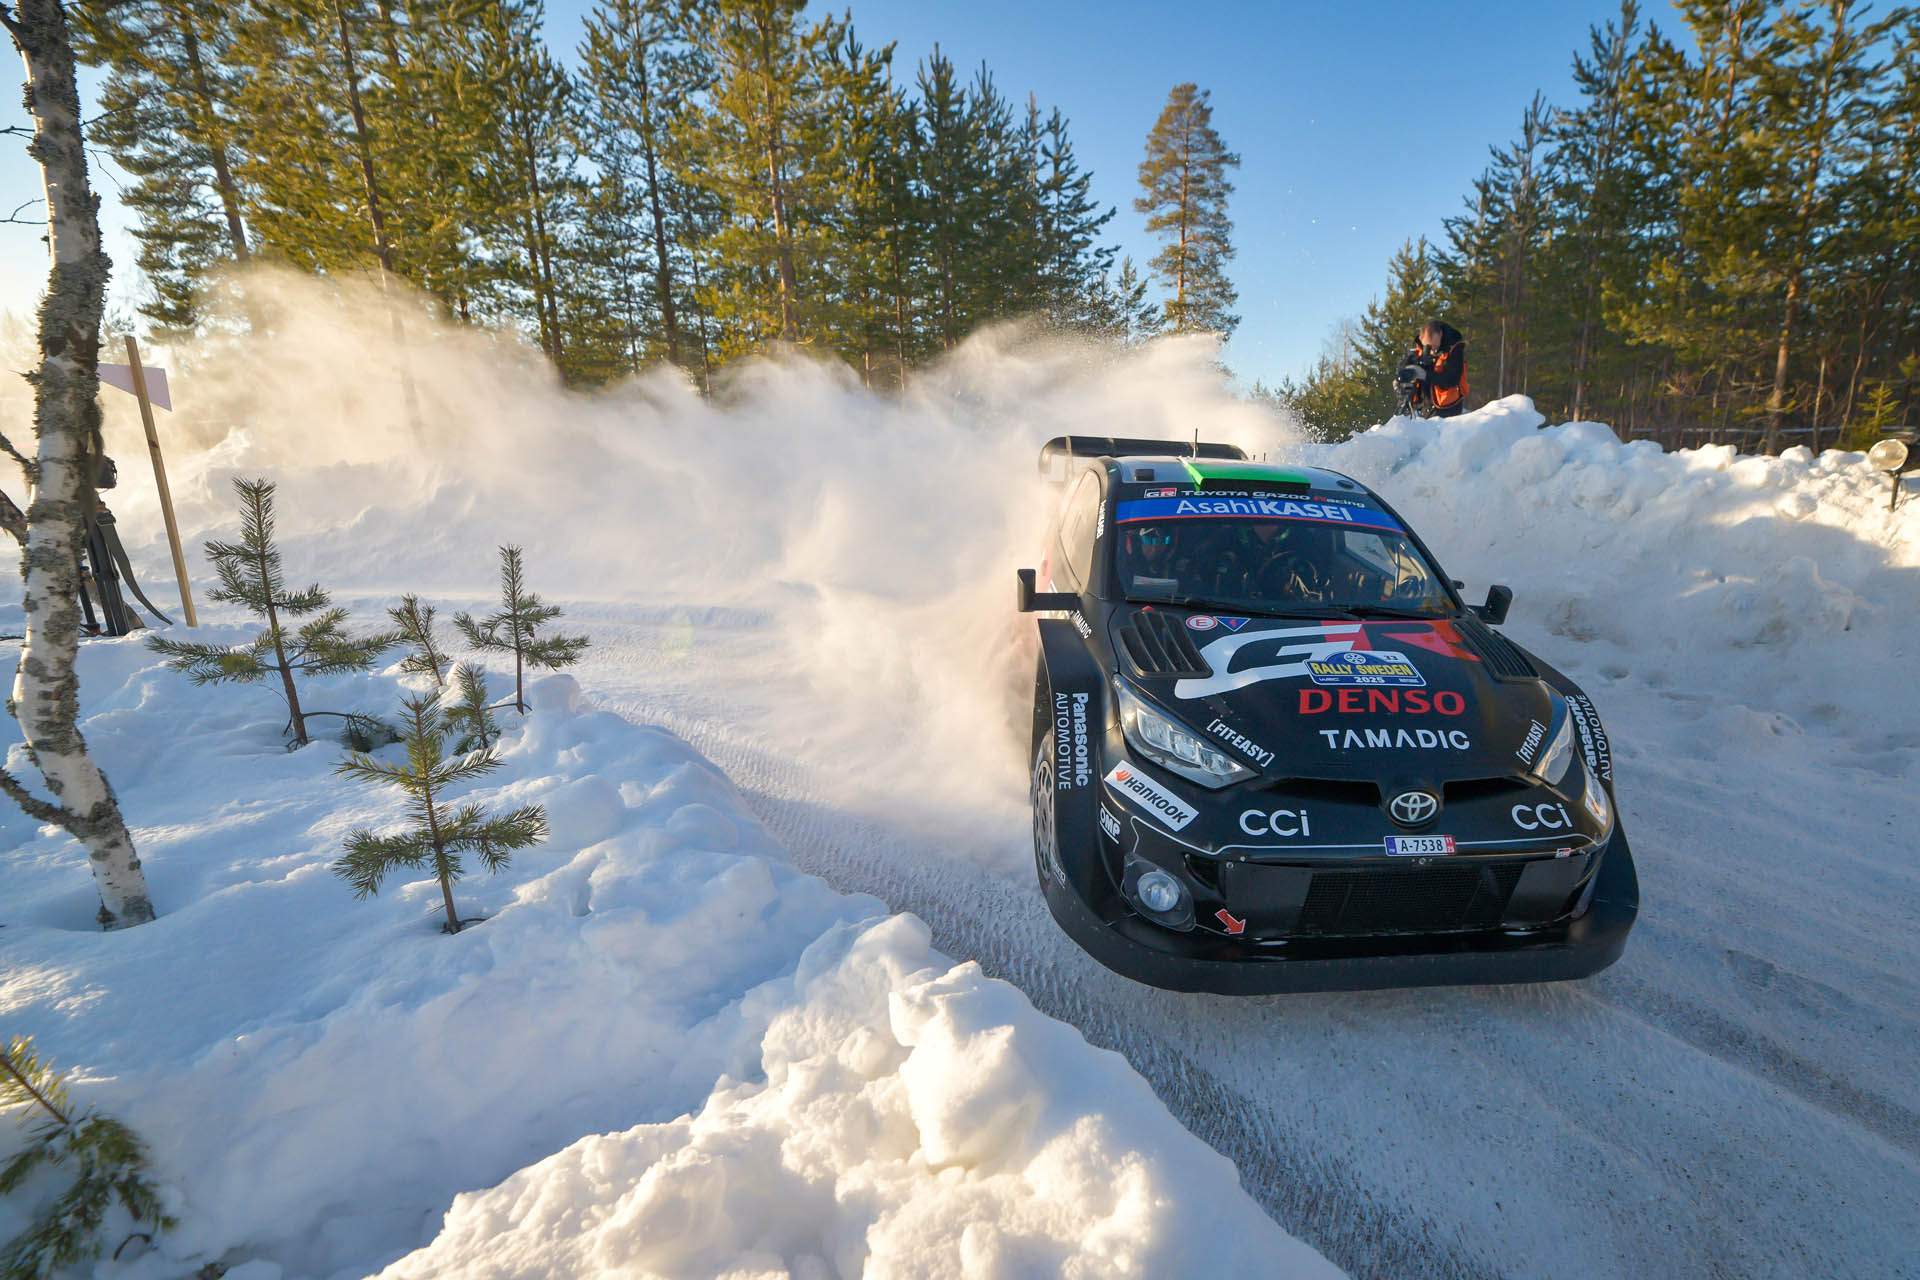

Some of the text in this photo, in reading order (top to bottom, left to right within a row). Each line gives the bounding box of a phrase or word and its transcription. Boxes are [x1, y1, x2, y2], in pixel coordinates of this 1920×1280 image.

[1145, 488, 1176, 498] GR
[1253, 491, 1309, 500] GAZOO
[1176, 500, 1353, 521] AsahiKASEI
[1310, 662, 1414, 676] RALLY SWEDEN
[1299, 689, 1465, 715] DENSO
[1055, 692, 1071, 790] AUTOMOTIVE
[1072, 692, 1092, 787] Panasonic
[1319, 729, 1470, 750] TAMADIC
[1576, 694, 1612, 781] AUTOMOTIVE
[1100, 810, 1121, 838] OMP
[1401, 839, 1443, 852] A-7538
